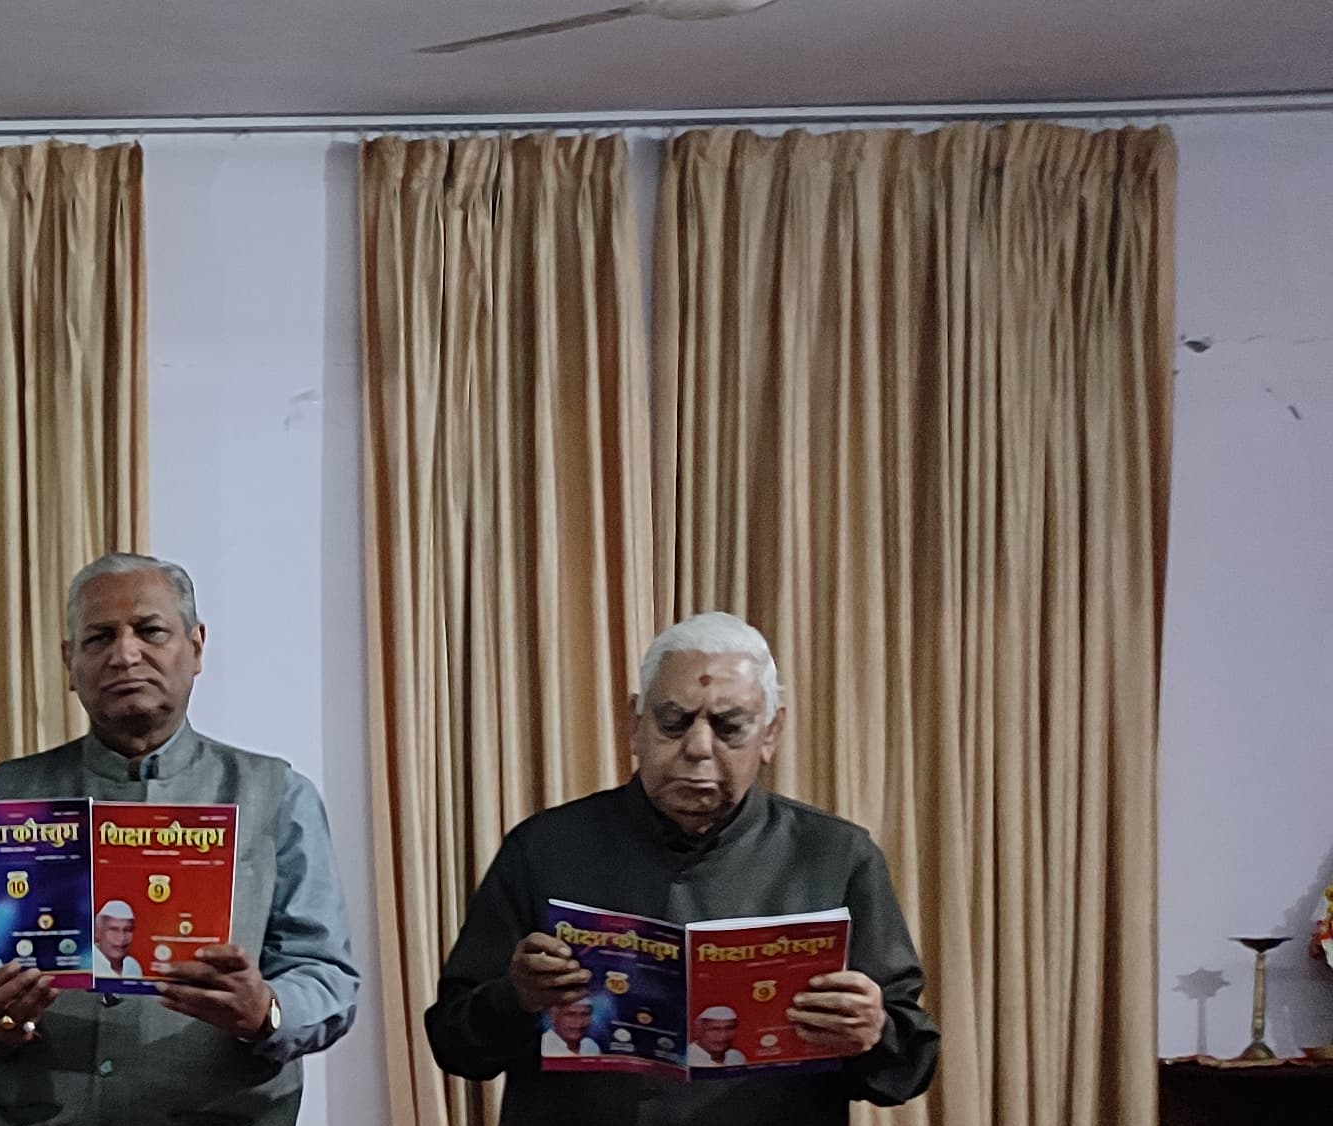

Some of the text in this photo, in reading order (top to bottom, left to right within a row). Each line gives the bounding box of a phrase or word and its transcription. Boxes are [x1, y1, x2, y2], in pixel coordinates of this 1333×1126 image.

[99, 821, 152, 847] शिक्षा
[553, 920, 608, 948] शिक्षा
[696, 941, 757, 963] शिक्षा
